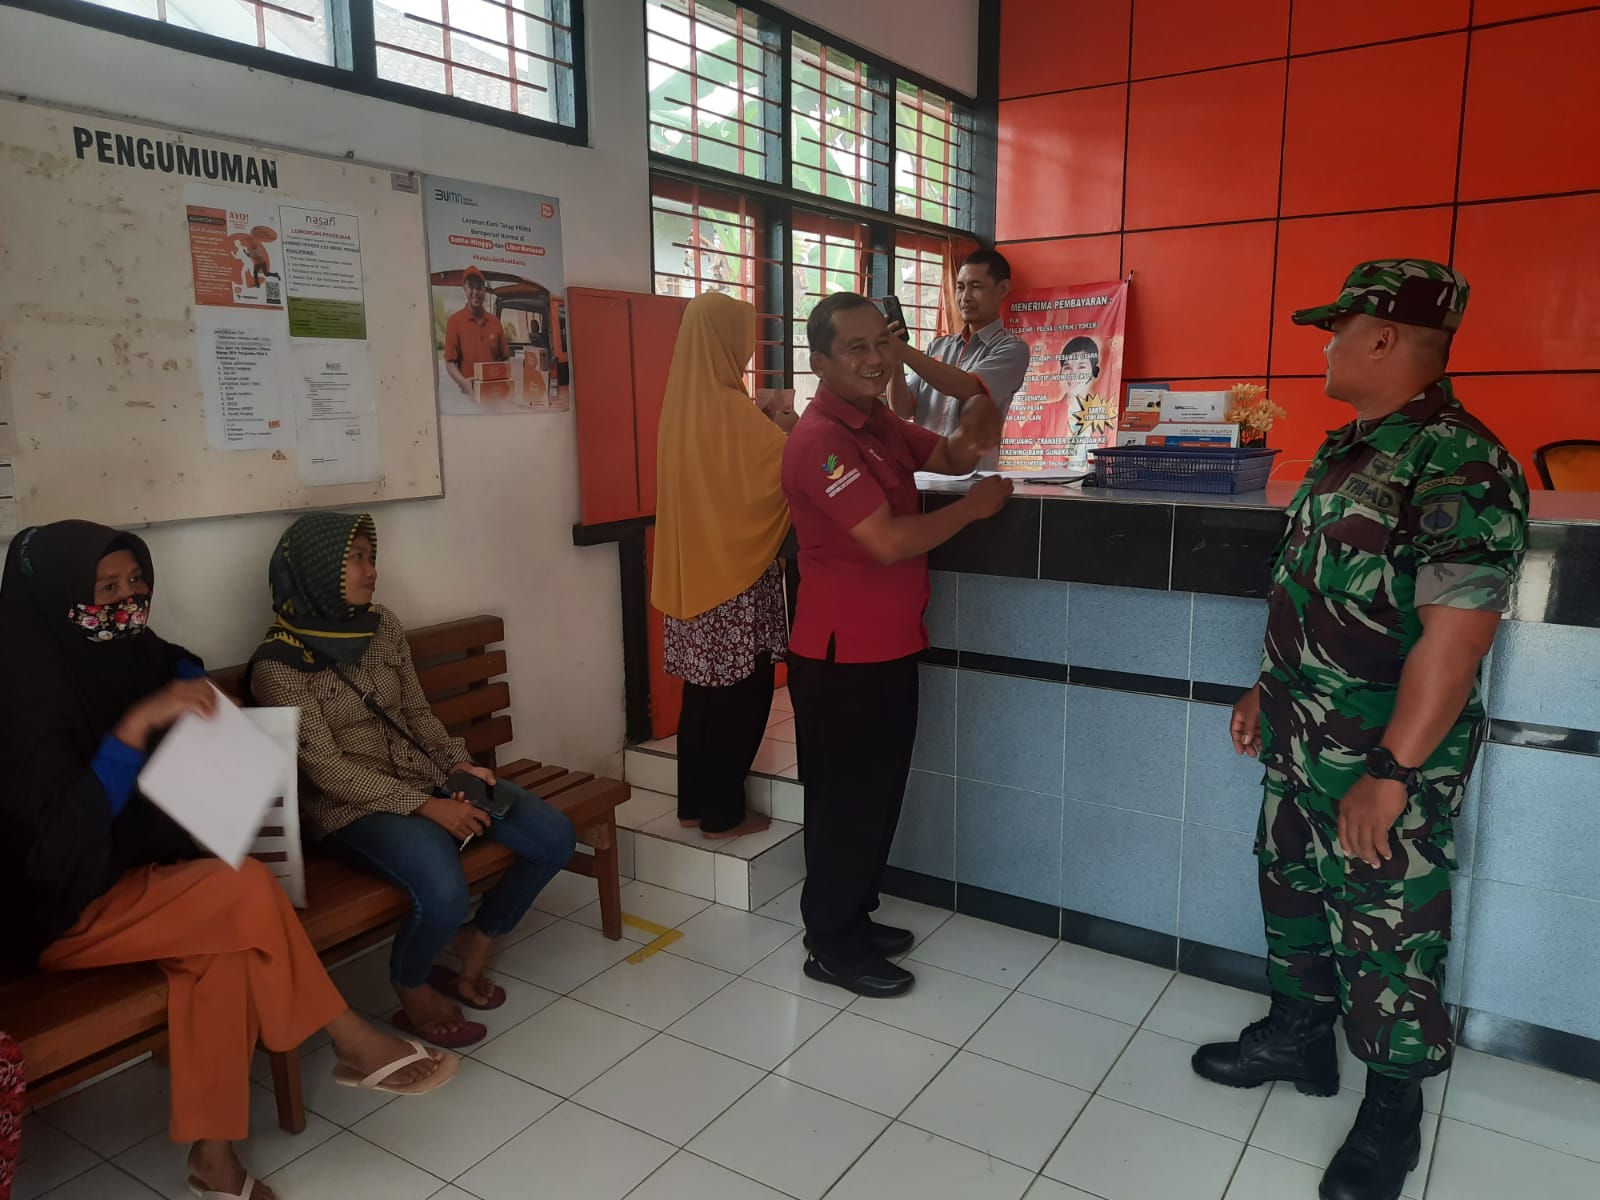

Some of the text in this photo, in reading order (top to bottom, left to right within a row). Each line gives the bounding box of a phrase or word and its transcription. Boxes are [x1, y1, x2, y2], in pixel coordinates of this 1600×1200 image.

[74, 126, 278, 188] PENGUMUMAN
[1010, 301, 1052, 312] MENERIMA
[1053, 296, 1107, 309] PEMBAYARAN
